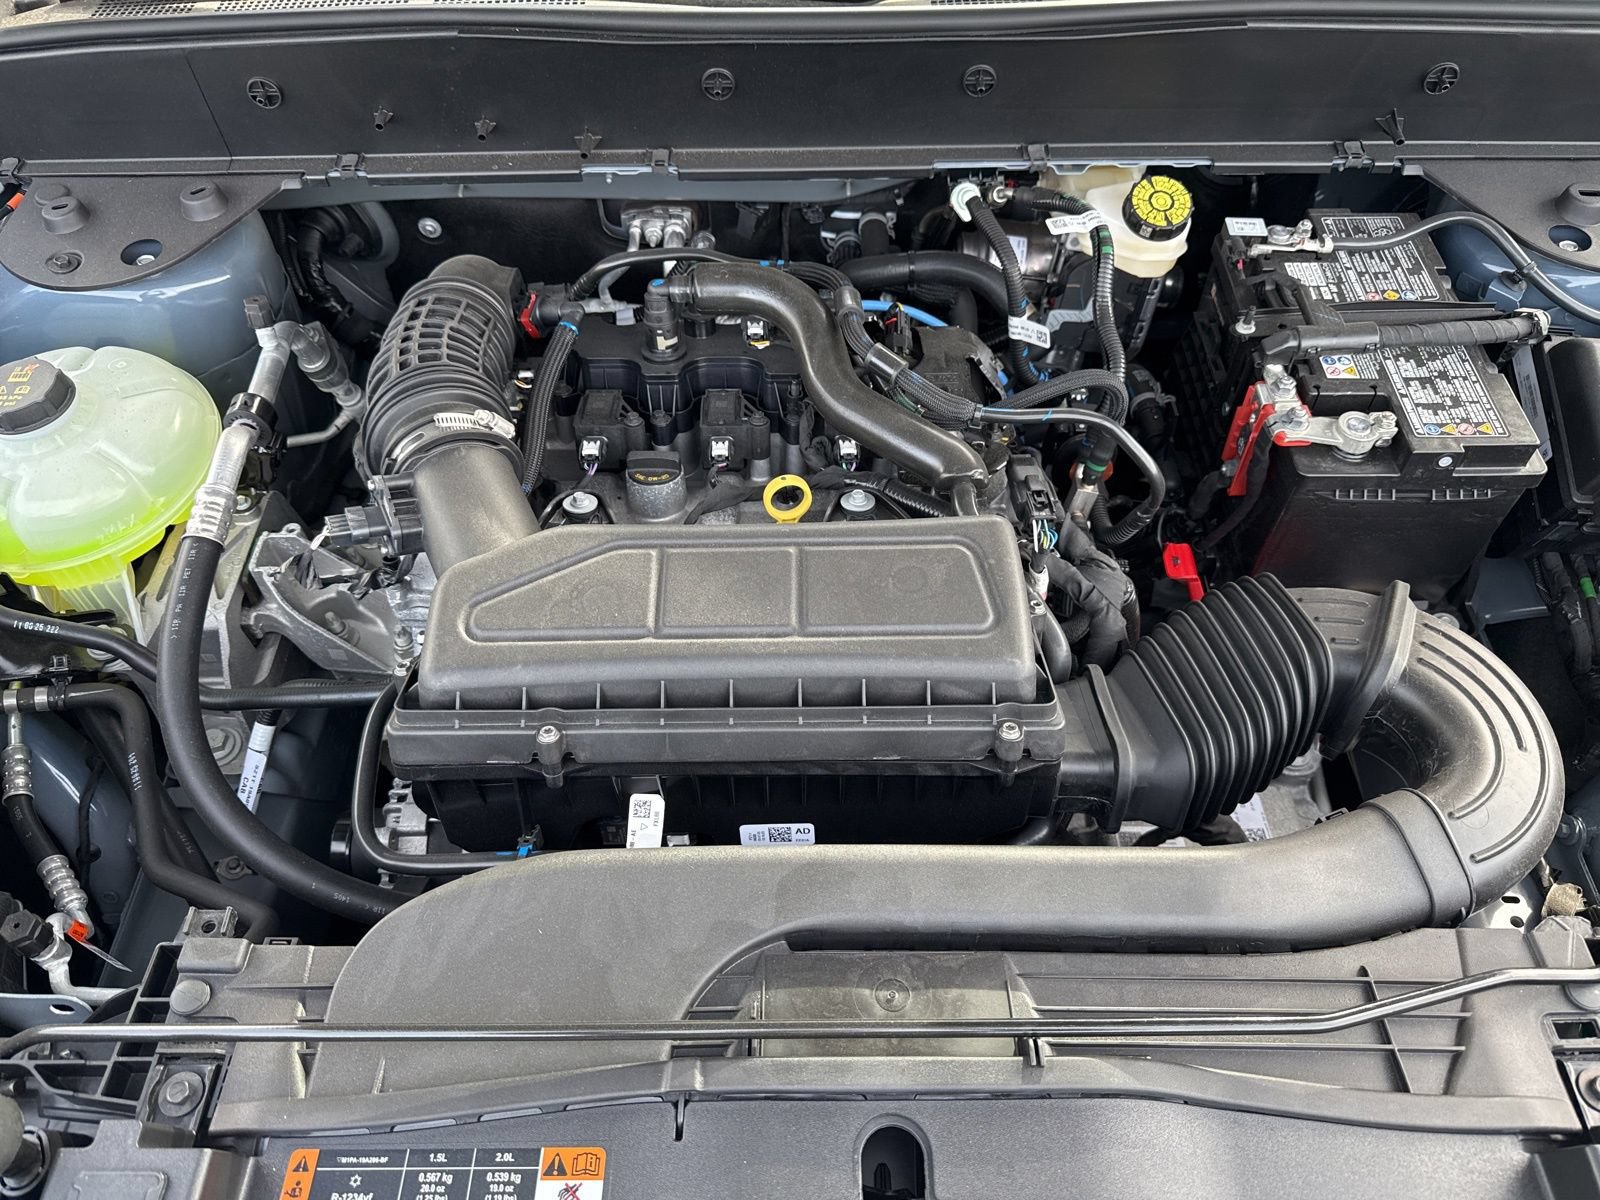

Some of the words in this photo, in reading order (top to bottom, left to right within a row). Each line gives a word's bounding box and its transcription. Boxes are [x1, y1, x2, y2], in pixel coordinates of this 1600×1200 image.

[795, 827, 811, 835] AD
[429, 1152, 448, 1163] 1.5L
[495, 1152, 515, 1162] 2.0L
[418, 1172, 442, 1183] 0.567
[441, 1172, 453, 1185] kg
[486, 1172, 510, 1182] 0.539
[510, 1172, 522, 1184] kg
[419, 1183, 436, 1193] 20.0
[436, 1185, 446, 1193] oz
[489, 1183, 505, 1193] 19.0
[504, 1185, 515, 1193] oz
